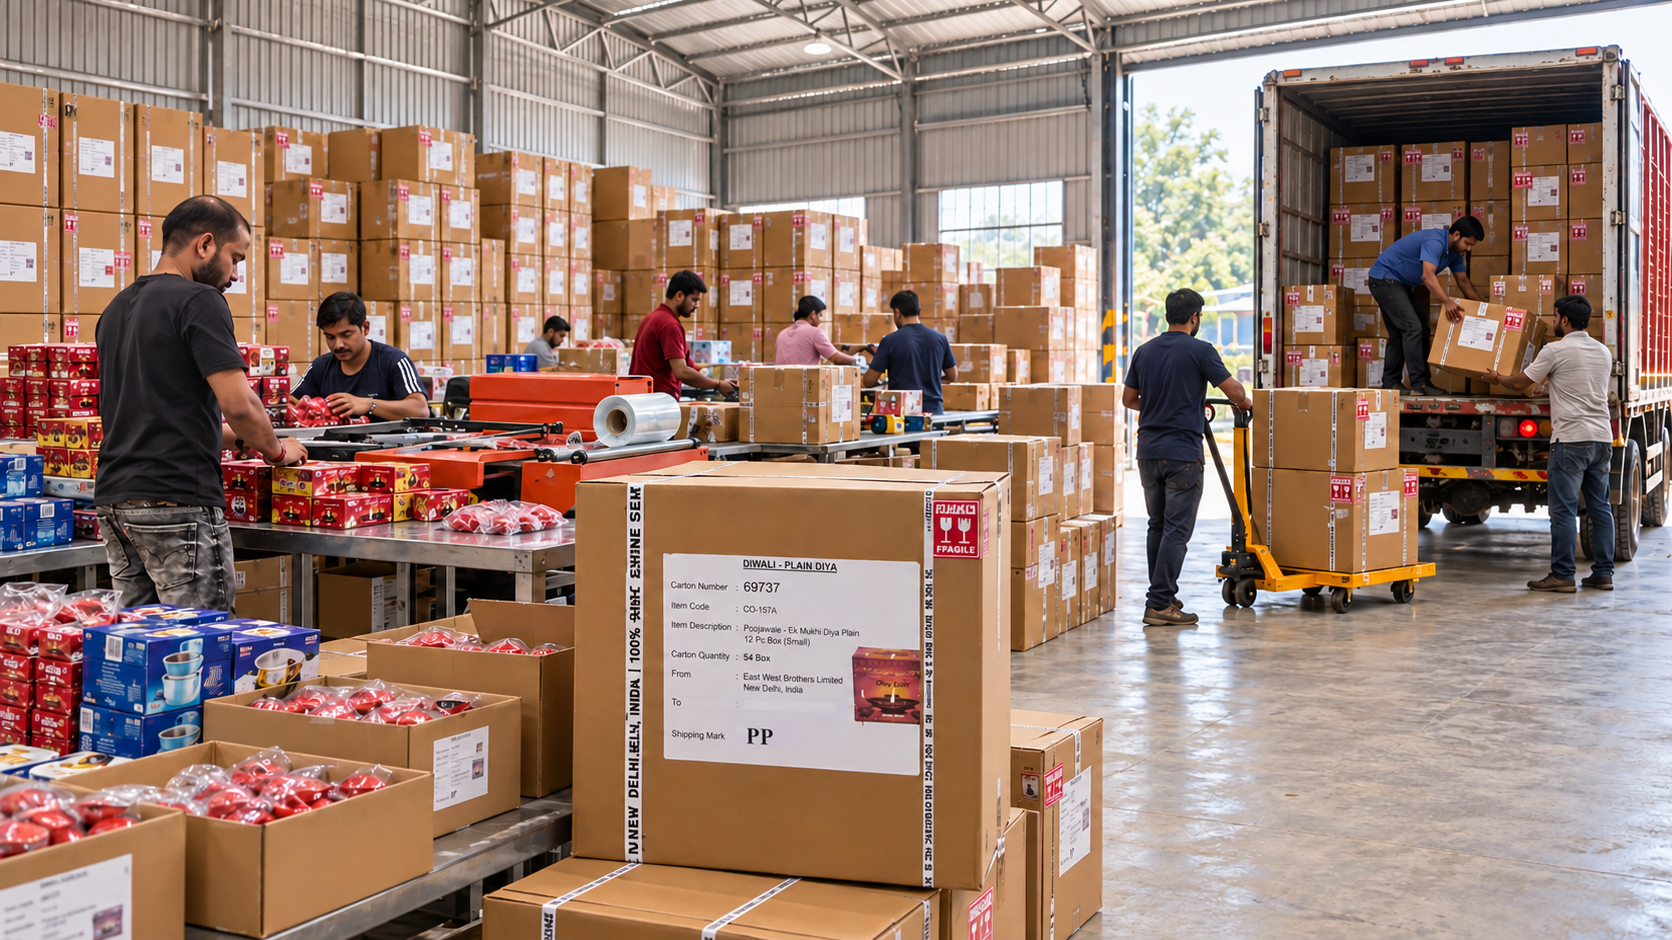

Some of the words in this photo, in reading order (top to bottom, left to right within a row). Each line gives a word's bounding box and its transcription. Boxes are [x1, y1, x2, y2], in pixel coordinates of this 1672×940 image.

[743, 560, 776, 568] DIWALI
[784, 561, 812, 570] PLAIN
[816, 562, 837, 571] DIYA
[670, 581, 696, 590] Carton
[698, 582, 728, 591] Number
[744, 582, 780, 593] 69737
[690, 602, 710, 610] Code
[743, 606, 778, 614] CO-157A
[690, 622, 732, 632] Description
[788, 626, 798, 634] Ek
[800, 628, 822, 636] Mukhi
[824, 629, 840, 637] Diya
[630, 627, 641, 663] 100%
[756, 636, 766, 644] Pc
[768, 636, 782, 644] Box
[784, 637, 810, 647] (Small)
[671, 650, 696, 658] Carton
[698, 651, 730, 662] Quantity
[756, 654, 770, 662] Box
[672, 670, 692, 678] From
[743, 672, 760, 681] East
[762, 673, 782, 682] West
[784, 674, 814, 684] Brothers
[816, 676, 843, 684] Limited
[743, 684, 760, 692] New
[762, 684, 784, 694] Delhi,
[786, 686, 804, 694] India
[672, 698, 682, 706] To
[672, 730, 704, 740] Shipping
[706, 732, 726, 740] Mark
[746, 728, 774, 745] PP
